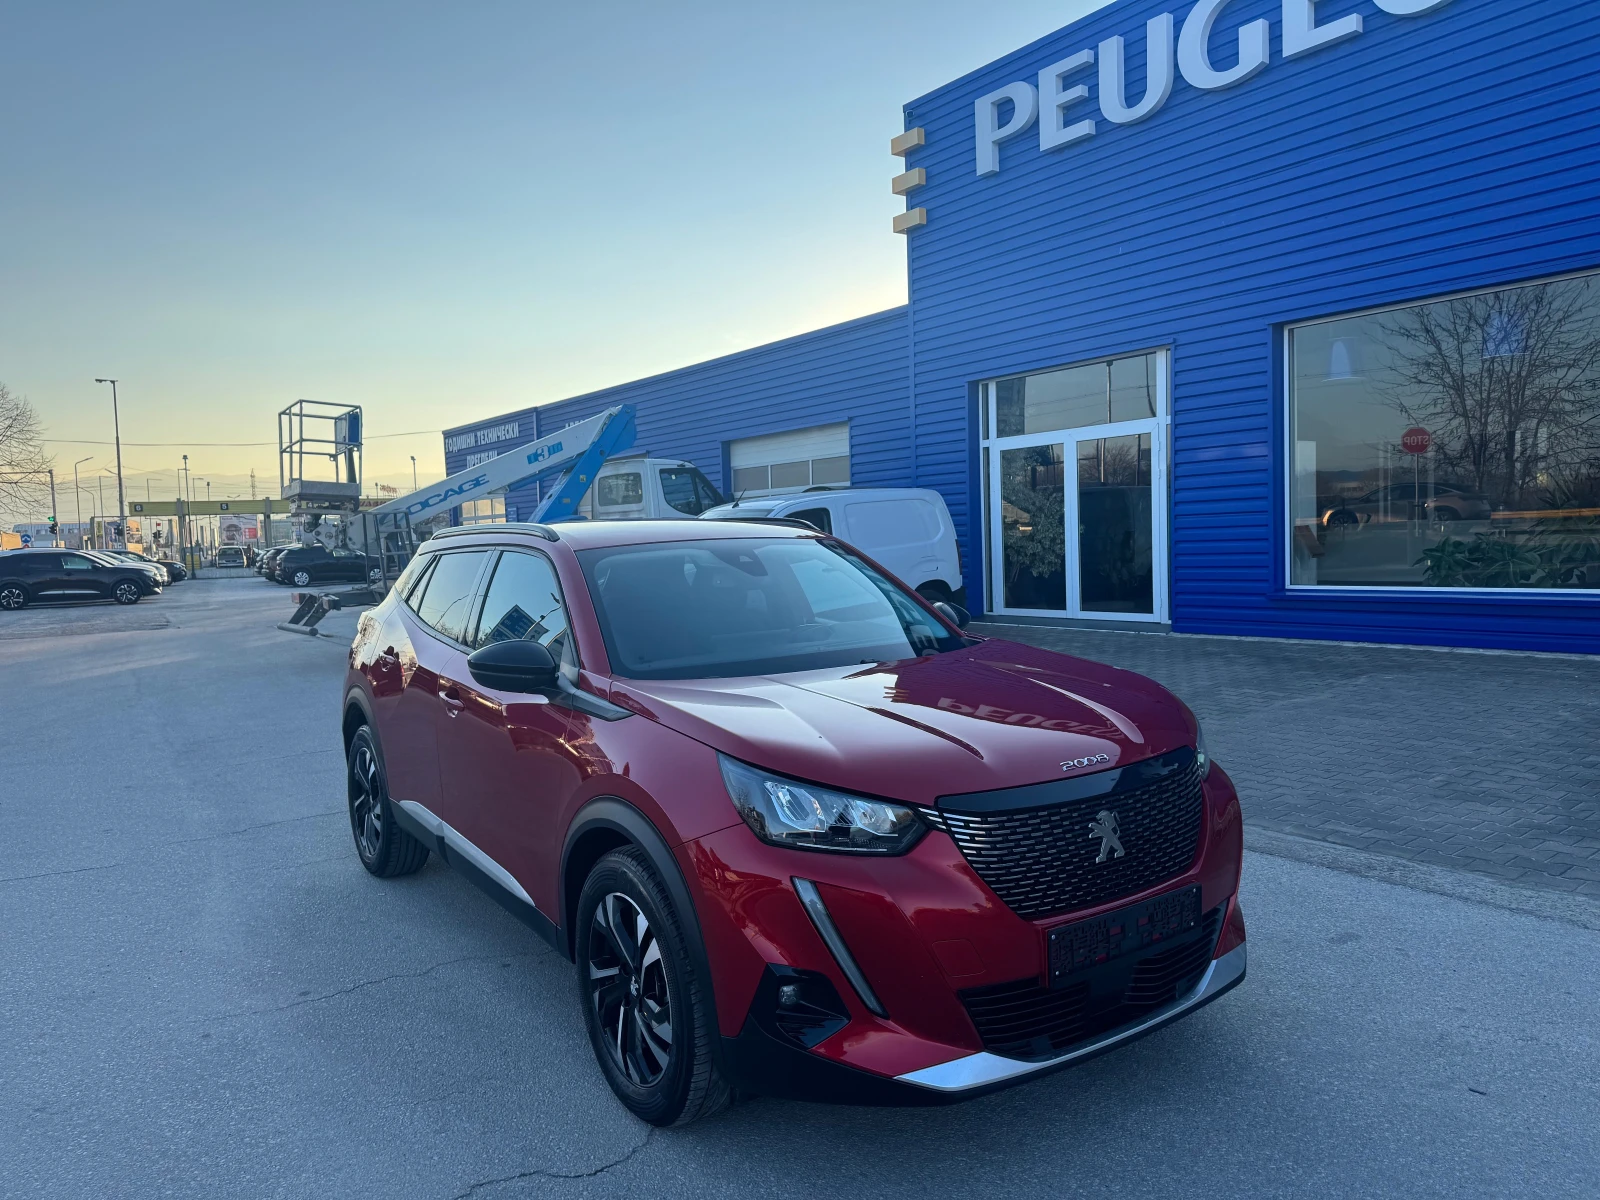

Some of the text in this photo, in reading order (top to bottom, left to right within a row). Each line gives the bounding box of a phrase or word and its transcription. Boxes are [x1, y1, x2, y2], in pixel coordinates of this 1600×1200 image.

[975, 0, 1453, 177] PEUGE
[445, 421, 519, 454] ГОДИШНИ ТЕХНИЧЕСКИ
[1059, 753, 1110, 772] 2008
